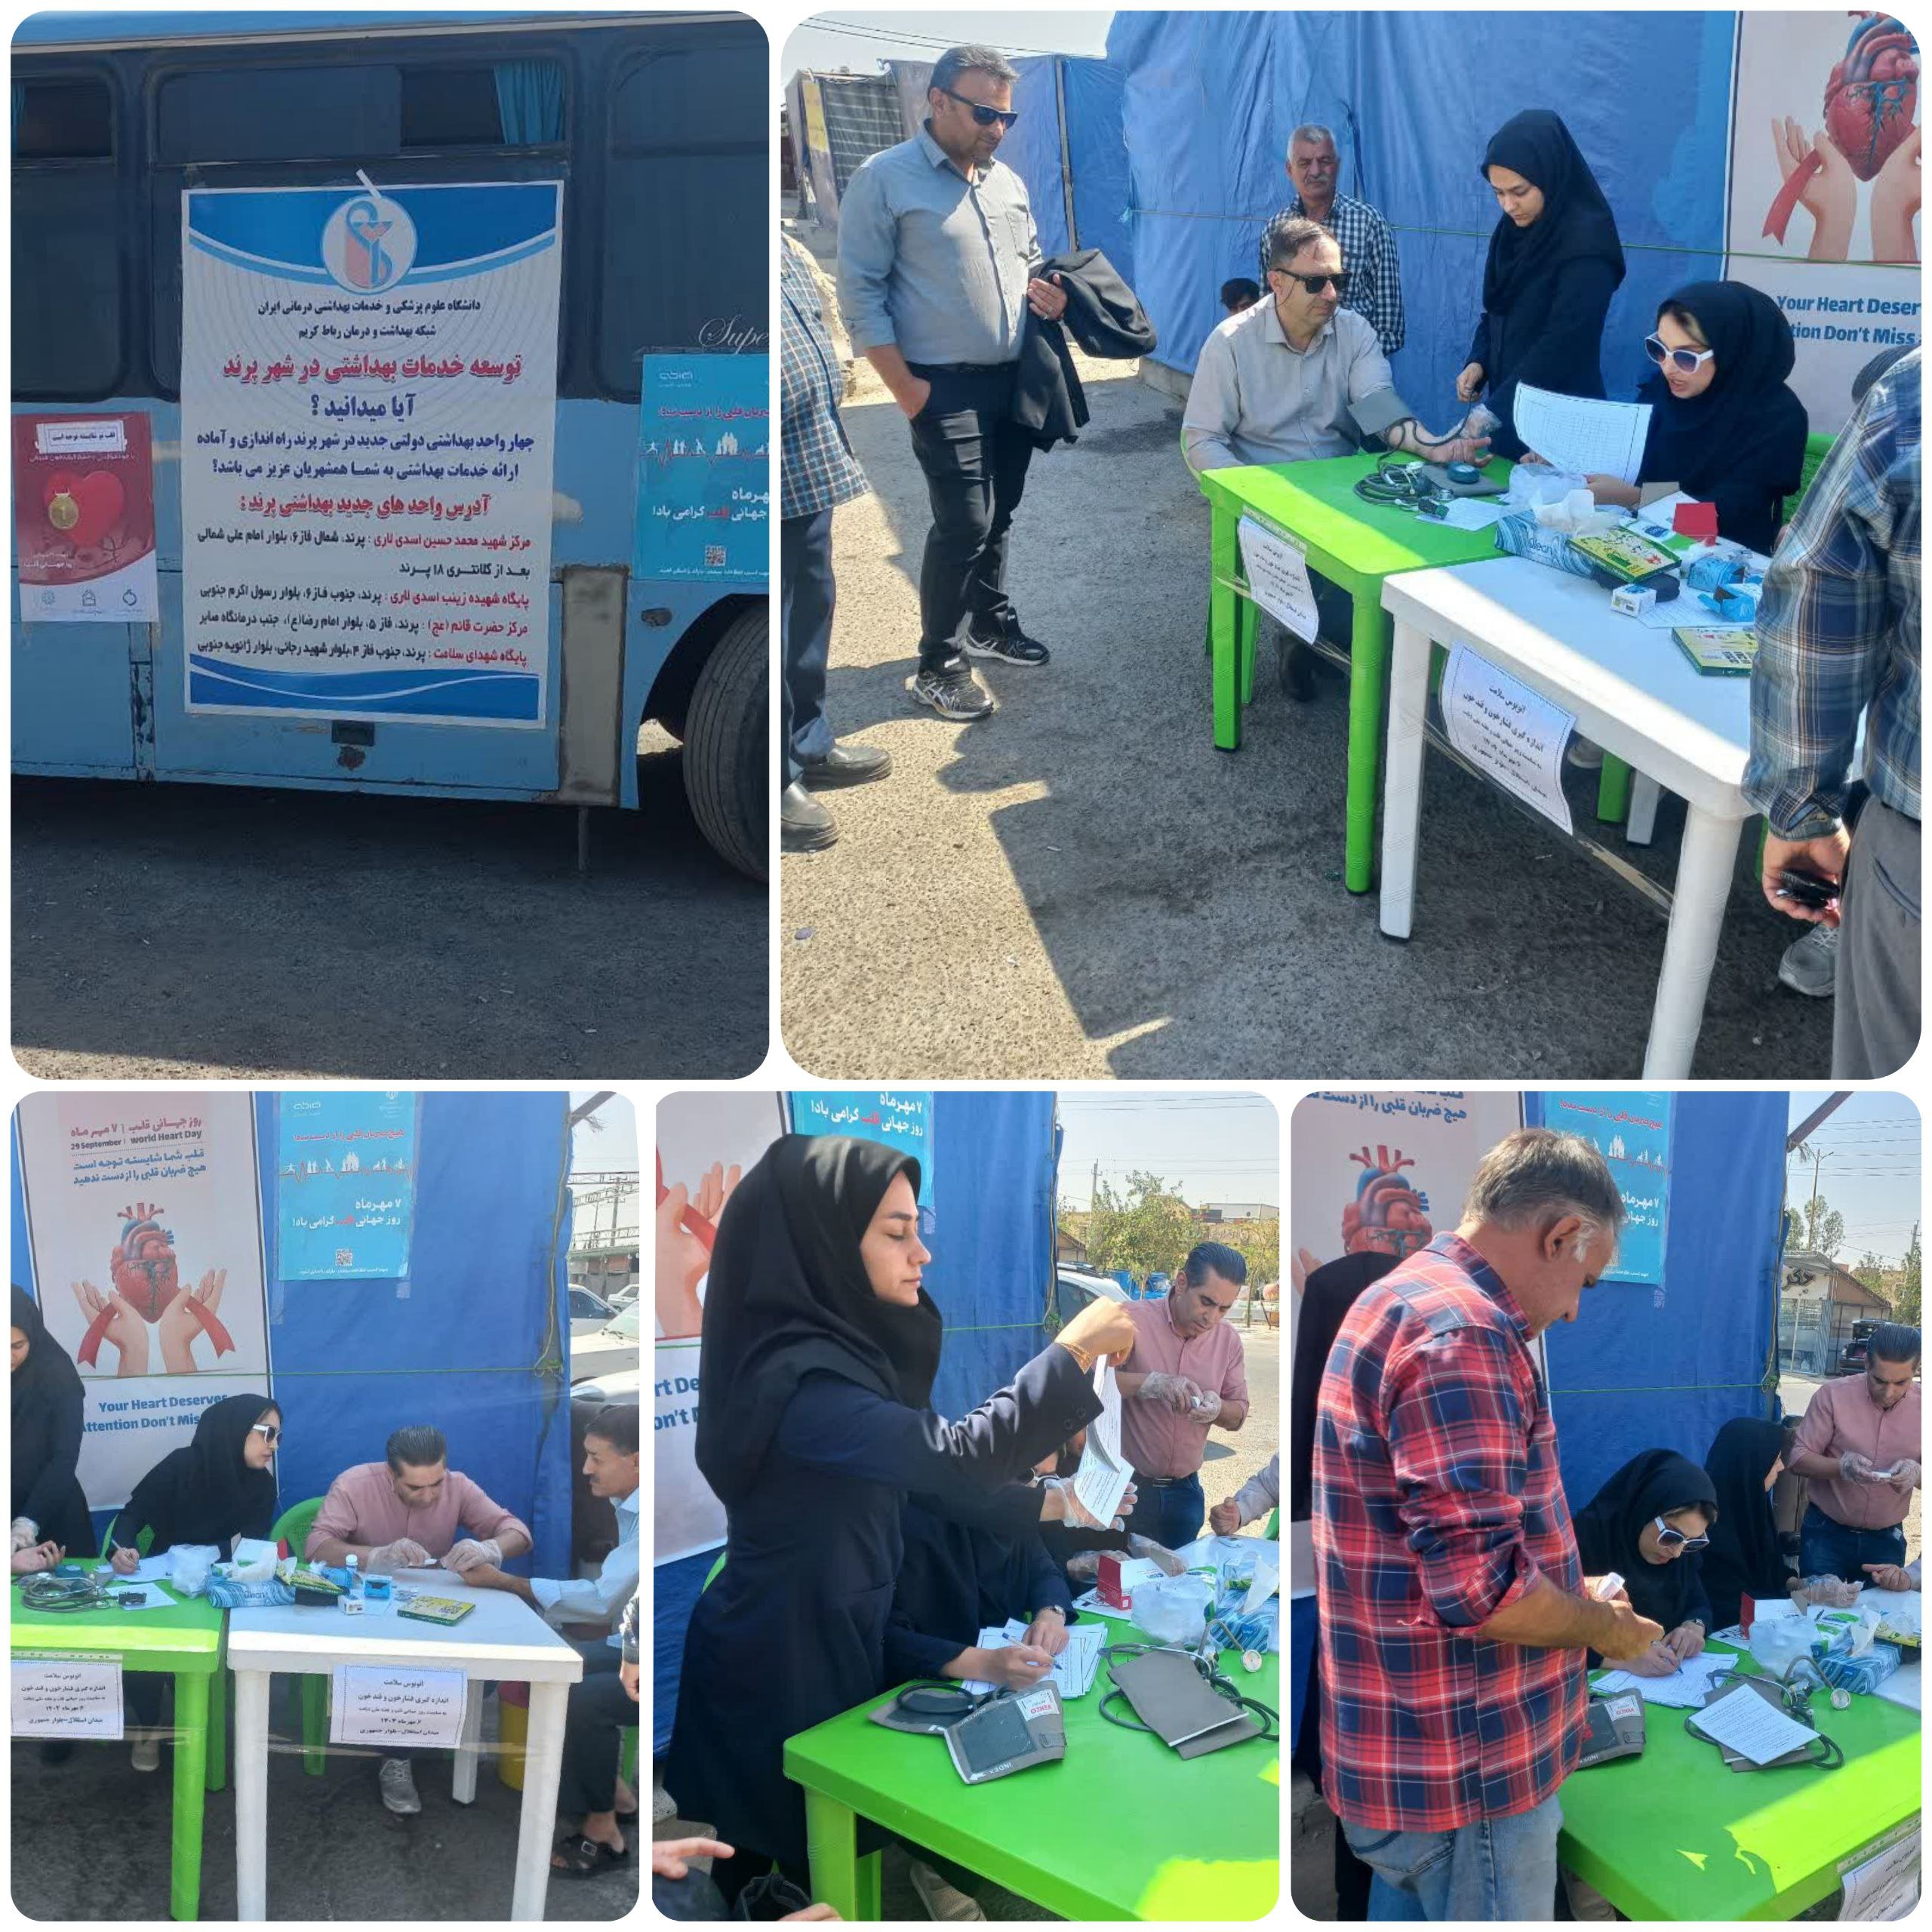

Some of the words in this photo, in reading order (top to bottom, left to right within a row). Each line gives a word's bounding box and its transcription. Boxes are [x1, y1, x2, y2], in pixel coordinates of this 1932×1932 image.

[258, 302, 280, 315] ایران
[282, 301, 312, 314] درمانی
[315, 300, 349, 314] بهداشتی
[352, 300, 382, 311] خدمات
[393, 301, 423, 315] پزشکی
[425, 301, 445, 313] علوم
[448, 300, 480, 311] دانشگاه
[1777, 296, 1814, 311] Your
[1817, 297, 1863, 313] Heart
[299, 325, 318, 340] کریم
[321, 325, 342, 339] رباط
[343, 326, 370, 338] درمان
[380, 325, 412, 337] بهداشت
[415, 326, 436, 337] شبکه
[1824, 325, 1869, 343] Don't
[1873, 328, 1915, 344] Miss
[223, 354, 258, 384] پرند
[261, 354, 294, 384] شهر
[302, 356, 320, 383] در
[325, 355, 397, 384] بهداشتی
[402, 355, 464, 377] خدمات
[469, 353, 521, 384] توسعه
[325, 395, 386, 422] میدانید
[392, 394, 416, 422] آیا
[197, 429, 226, 445] آماده
[294, 434, 317, 451] پرند
[321, 433, 340, 451] شهر
[343, 436, 355, 450] در
[357, 434, 388, 450] جدید
[390, 432, 424, 451] دولتی
[427, 433, 473, 451] بهداشتی
[476, 434, 505, 452] واحد
[509, 432, 534, 452] چهار
[246, 464, 263, 478] می
[266, 462, 290, 478] عزیز
[294, 461, 348, 479] همشهریان
[384, 463, 394, 478] به
[396, 460, 444, 480] بهداشتی
[448, 461, 488, 477] خدمات
[492, 462, 518, 481] ارائه
[279, 494, 334, 518] بهداشتی
[337, 495, 373, 515] جدید
[377, 494, 405, 518] های
[408, 494, 442, 520] واحد
[446, 494, 491, 521] آدرس
[198, 528, 224, 543] شمالی
[227, 530, 243, 543] علی
[245, 530, 263, 543] امام
[266, 530, 288, 544] بلوار
[315, 531, 338, 545] شمال
[374, 532, 393, 548] لاری
[395, 534, 421, 548] اسدی
[423, 536, 451, 549] حسین
[454, 536, 478, 546] محمد
[481, 534, 506, 550] شهید
[509, 535, 531, 550] مرکز
[494, 565, 503, 579] از
[200, 585, 226, 598] جنوبی
[228, 584, 248, 598] اکرم
[251, 585, 277, 599] رسول
[279, 586, 300, 602] بلوار
[331, 589, 355, 602] جنوب
[391, 589, 410, 604] لاری
[413, 592, 438, 605] اسدی
[443, 592, 466, 606] زینب
[469, 592, 500, 607] شهیده
[503, 592, 529, 611] پایگاه
[222, 610, 257, 626] درمانگاه
[260, 614, 278, 628] جنب
[321, 614, 339, 629] امام
[342, 615, 362, 631] بلوار
[380, 617, 392, 632] فاز
[473, 620, 503, 635] حضرت
[507, 620, 528, 636] مرکز
[198, 640, 223, 654] جنوبی
[254, 641, 272, 654] بلوار
[303, 642, 327, 657] شهید
[377, 645, 401, 660] جنوب
[434, 648, 463, 660] سلامت
[466, 648, 497, 663] شهدای
[500, 648, 527, 667] پایگاه
[879, 1091, 915, 1114] مهرماه
[1371, 1095, 1378, 1112] را
[1382, 1098, 1406, 1115] قلبی
[1408, 1102, 1441, 1118] ضربان
[831, 1105, 859, 1123] گرامی
[1443, 1107, 1466, 1123] هیچ
[128, 1119, 149, 1134] قلب
[152, 1117, 186, 1132] جهانی
[189, 1117, 202, 1128] روز
[881, 1115, 909, 1133] جهانی
[912, 1120, 923, 1137] روز
[81, 1138, 122, 1149] September
[158, 1131, 183, 1143] Heart
[184, 1131, 202, 1140] Day
[125, 1152, 162, 1165] شایسته
[165, 1150, 183, 1162] شما
[185, 1149, 204, 1160] قلب
[74, 1159, 97, 1171] است
[99, 1156, 123, 1169] توجه
[101, 1172, 123, 1181] دست
[134, 1170, 139, 1180] را
[140, 1168, 159, 1180] قلبی
[162, 1164, 186, 1177] ضربان
[188, 1164, 207, 1177] هیچ
[74, 1172, 100, 1185] ندهید
[355, 1198, 392, 1212] مهرماه
[309, 1217, 334, 1229] گرامی
[355, 1217, 383, 1227] جهانی
[1647, 1215, 1658, 1227] روز
[99, 1400, 129, 1413] Your
[131, 1398, 167, 1411] Heart
[141, 1416, 174, 1429] Don't
